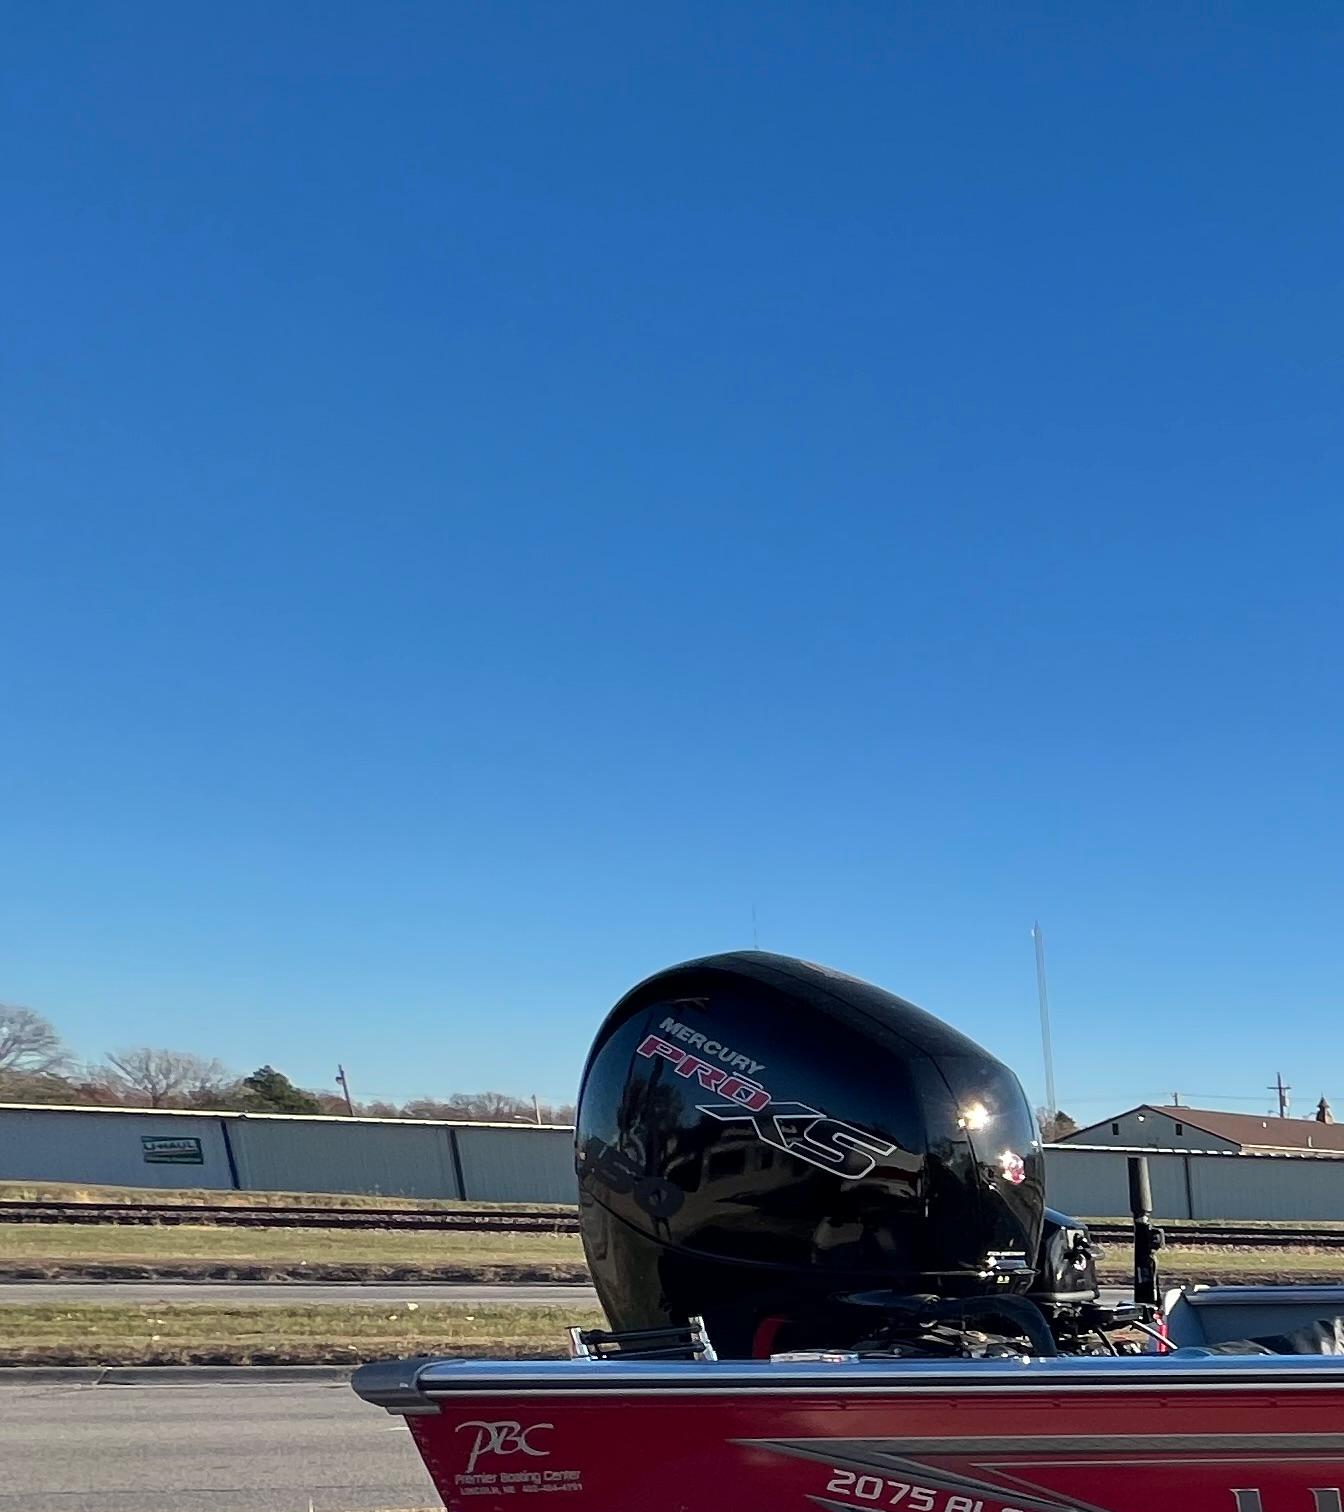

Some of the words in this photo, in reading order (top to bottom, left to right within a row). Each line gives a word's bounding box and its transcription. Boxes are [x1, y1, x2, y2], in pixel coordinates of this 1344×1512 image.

[636, 1033, 772, 1112] PRO
[659, 1016, 767, 1075] MERCURY
[694, 1101, 898, 1180] XS
[454, 1420, 554, 1473] PBC
[825, 1468, 938, 1512] 2075
